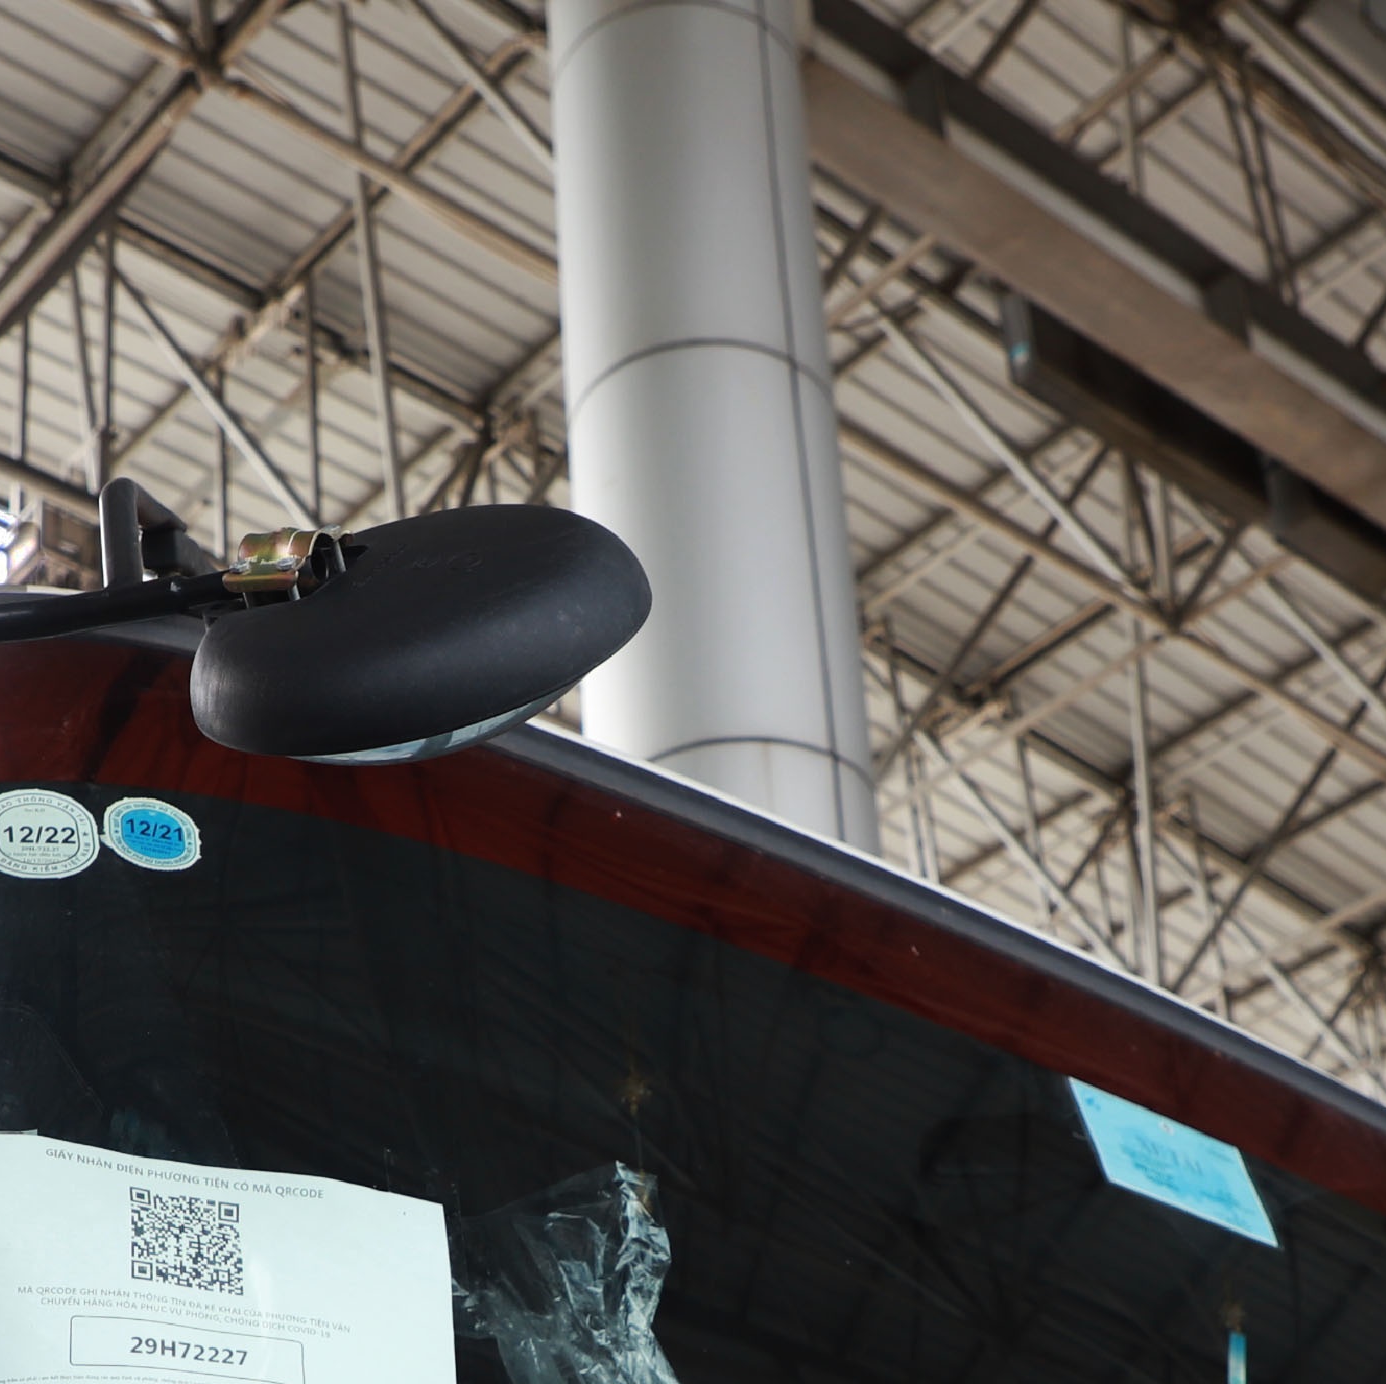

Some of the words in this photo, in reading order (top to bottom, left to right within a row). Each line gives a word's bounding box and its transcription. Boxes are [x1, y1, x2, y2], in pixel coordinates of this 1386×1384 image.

[3, 825, 77, 845] 12/22
[125, 818, 183, 842] 12/21
[275, 1186, 326, 1199] QRCODE
[129, 1336, 248, 1366] 29H72227
